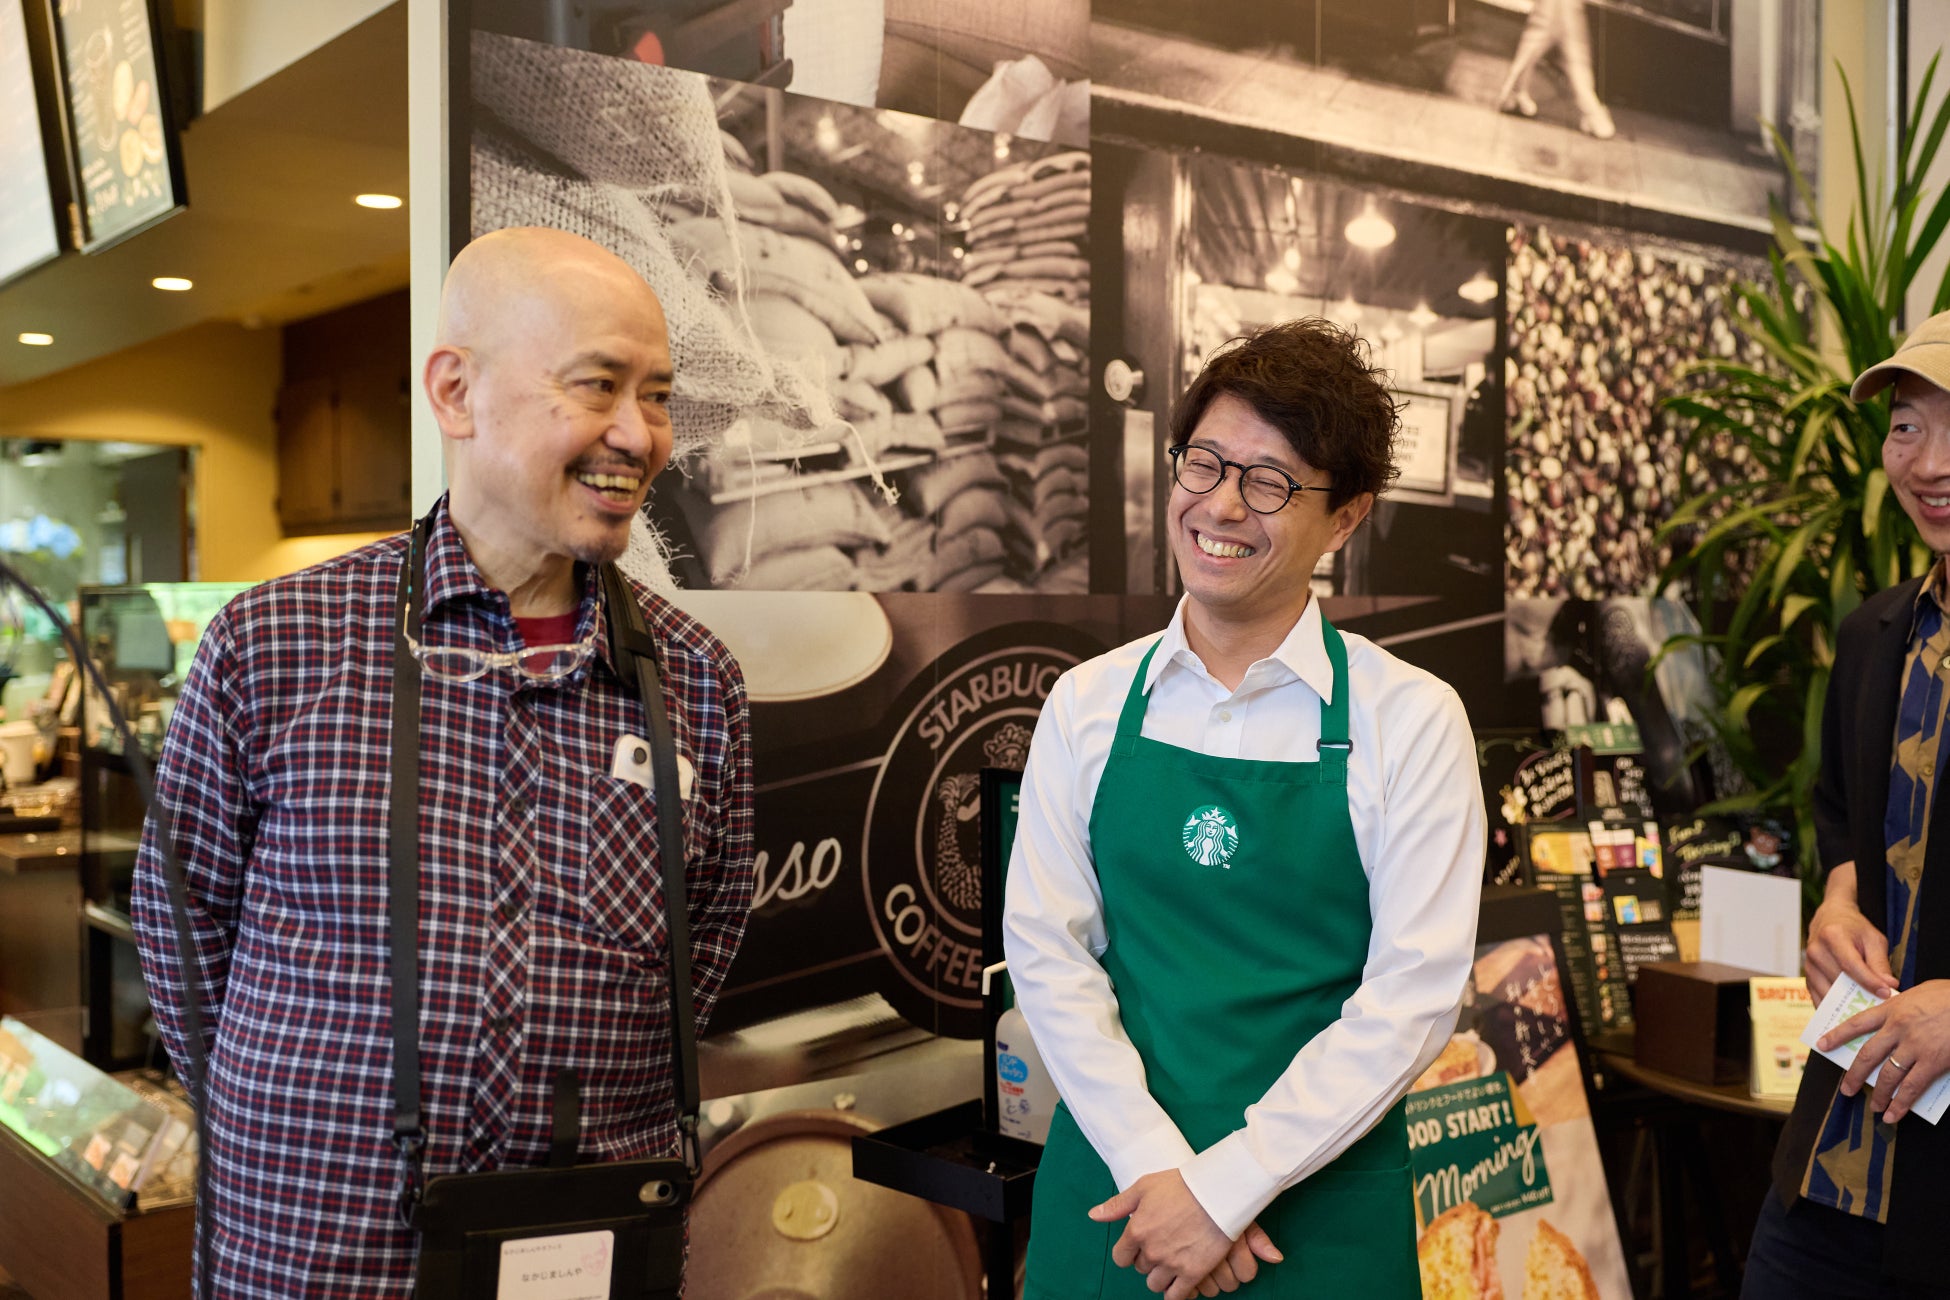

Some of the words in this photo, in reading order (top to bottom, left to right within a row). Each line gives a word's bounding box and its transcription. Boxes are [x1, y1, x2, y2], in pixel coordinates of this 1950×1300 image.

[884, 883, 983, 989] COFFEE
[1446, 1100, 1513, 1139] START!
[1416, 1126, 1542, 1218] Morning
